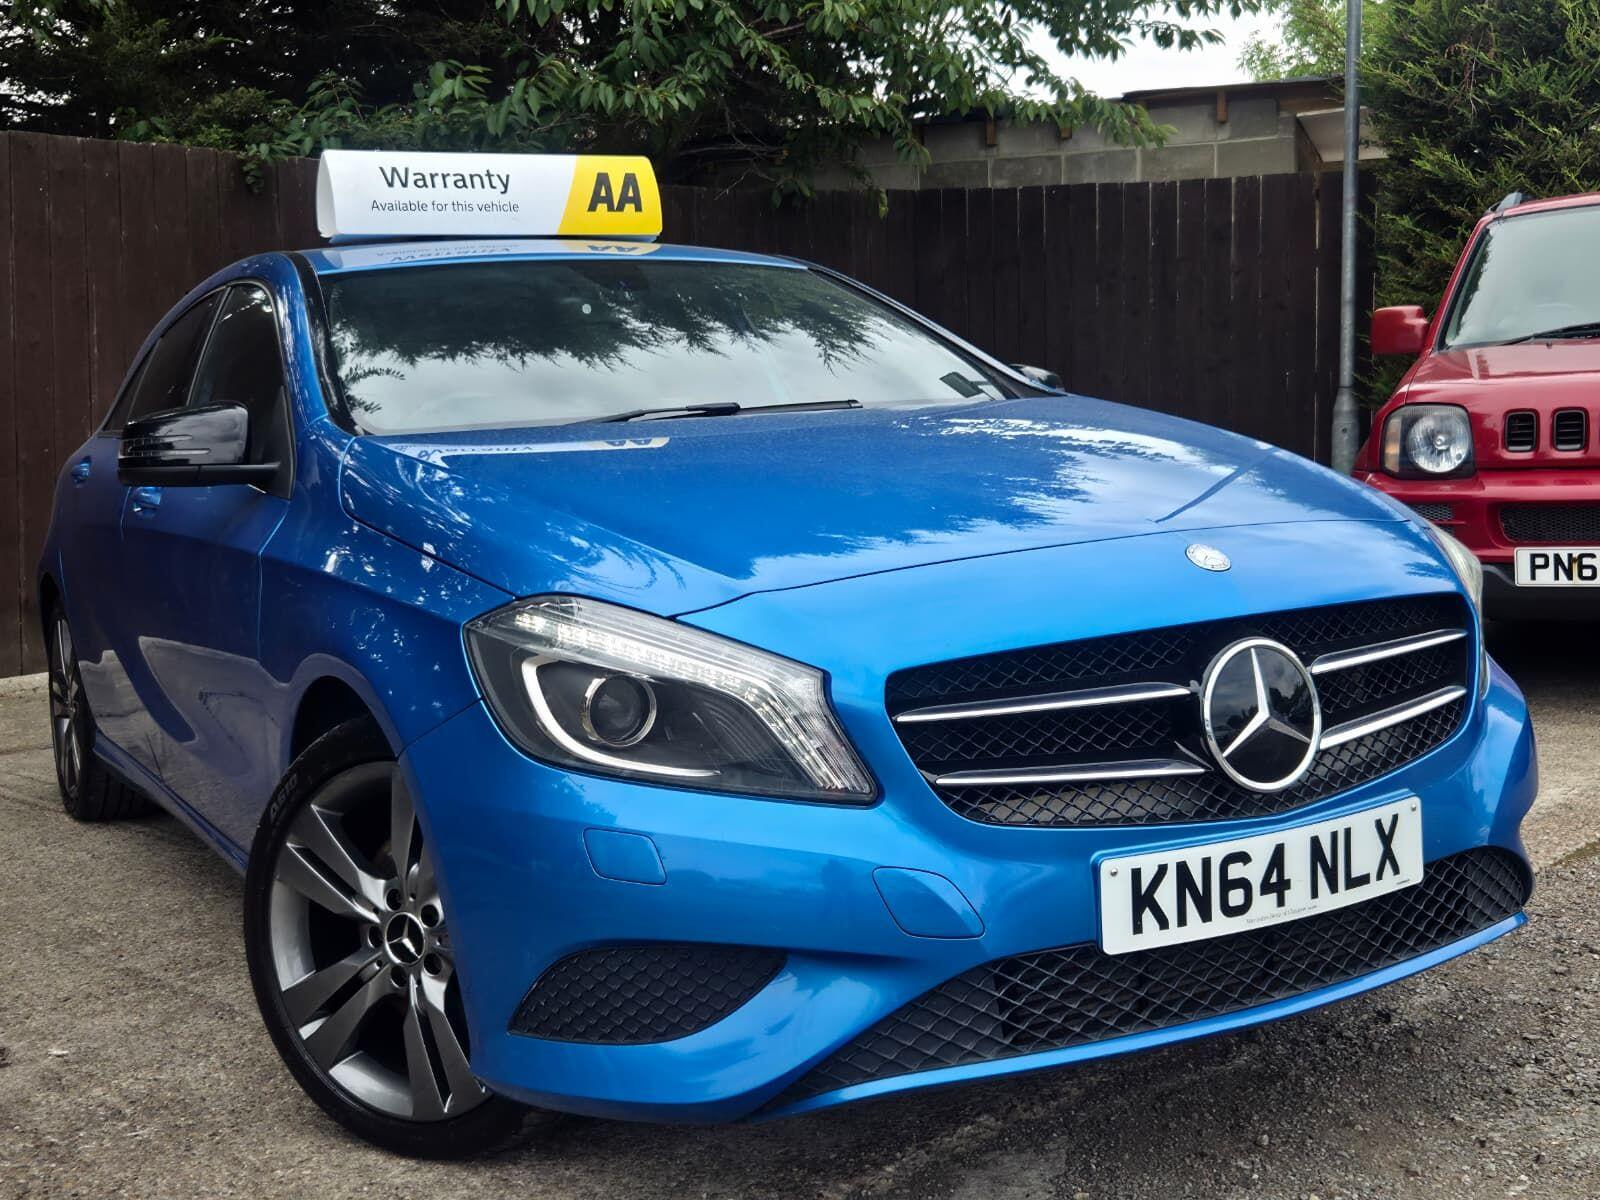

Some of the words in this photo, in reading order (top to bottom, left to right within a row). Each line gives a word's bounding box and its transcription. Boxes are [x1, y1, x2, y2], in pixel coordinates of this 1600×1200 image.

[379, 166, 510, 194] Warranty
[587, 172, 643, 212] AA
[371, 200, 429, 212] Available
[432, 200, 449, 212] for
[452, 200, 475, 212] this
[477, 201, 520, 213] vehicle
[1530, 553, 1598, 581] PN6
[1130, 842, 1292, 936] KN64
[1310, 813, 1401, 900] NLX
